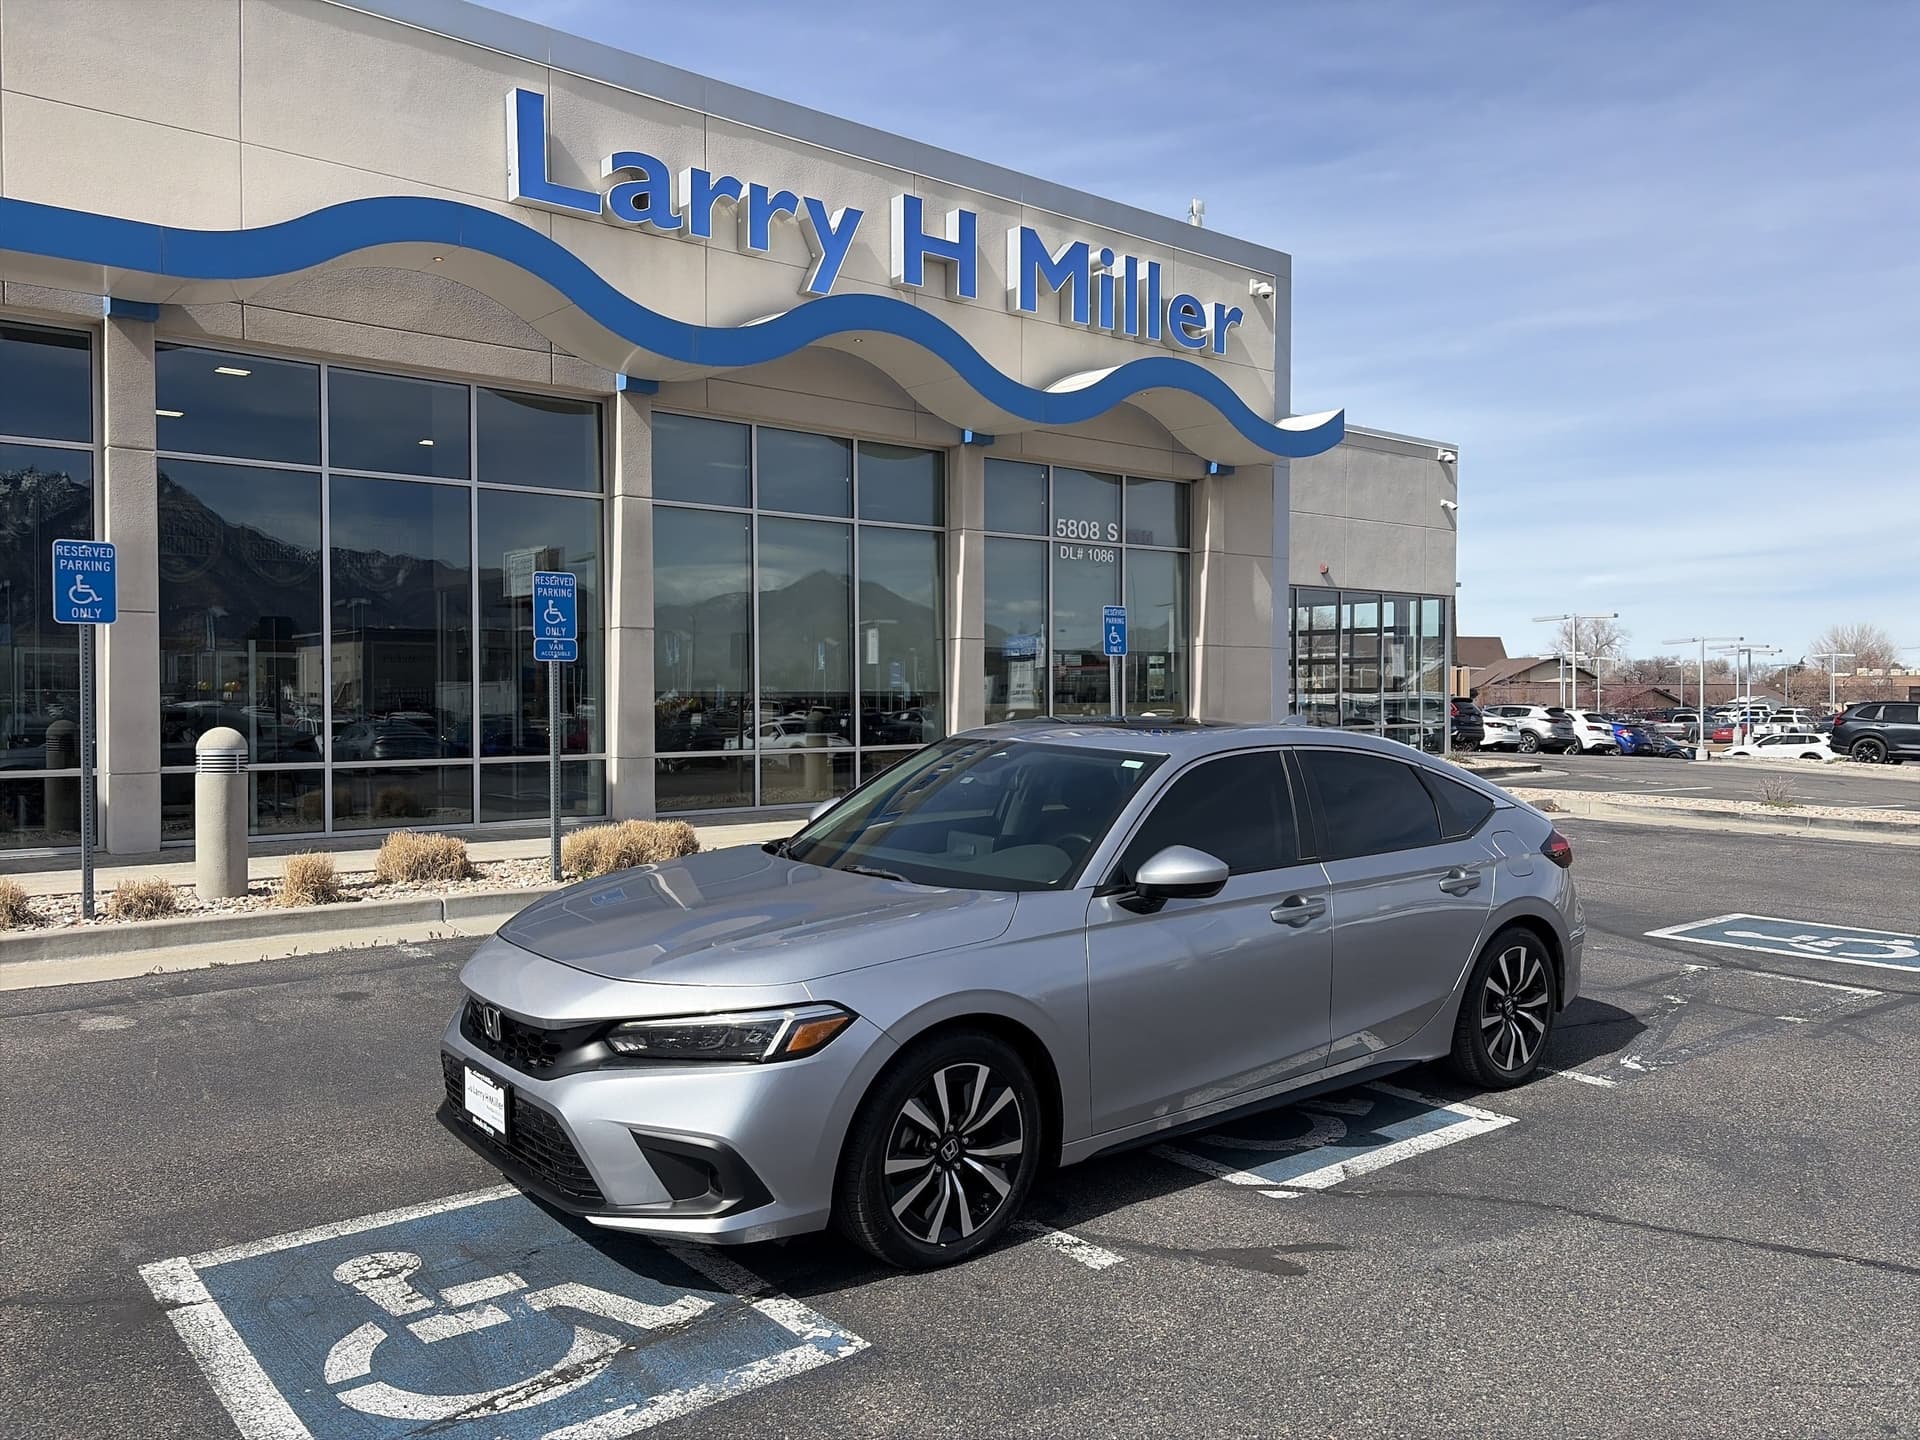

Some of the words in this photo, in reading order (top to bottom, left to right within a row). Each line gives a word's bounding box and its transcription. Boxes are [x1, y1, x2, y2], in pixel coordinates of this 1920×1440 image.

[507, 87, 864, 297] Larry
[891, 192, 978, 300] H
[1007, 225, 1243, 355] Miller
[1056, 518, 1100, 540] 5808
[1107, 522, 1118, 541] S
[55, 544, 114, 559] RESERVED
[1060, 545, 1084, 560] DL#
[1088, 548, 1114, 563] 1086
[60, 559, 111, 572] PARKING
[535, 575, 574, 586] RESERVED
[538, 587, 572, 598] PARKING
[71, 607, 102, 618] ONLY
[545, 627, 567, 636] ONLY
[549, 643, 564, 651] VAN
